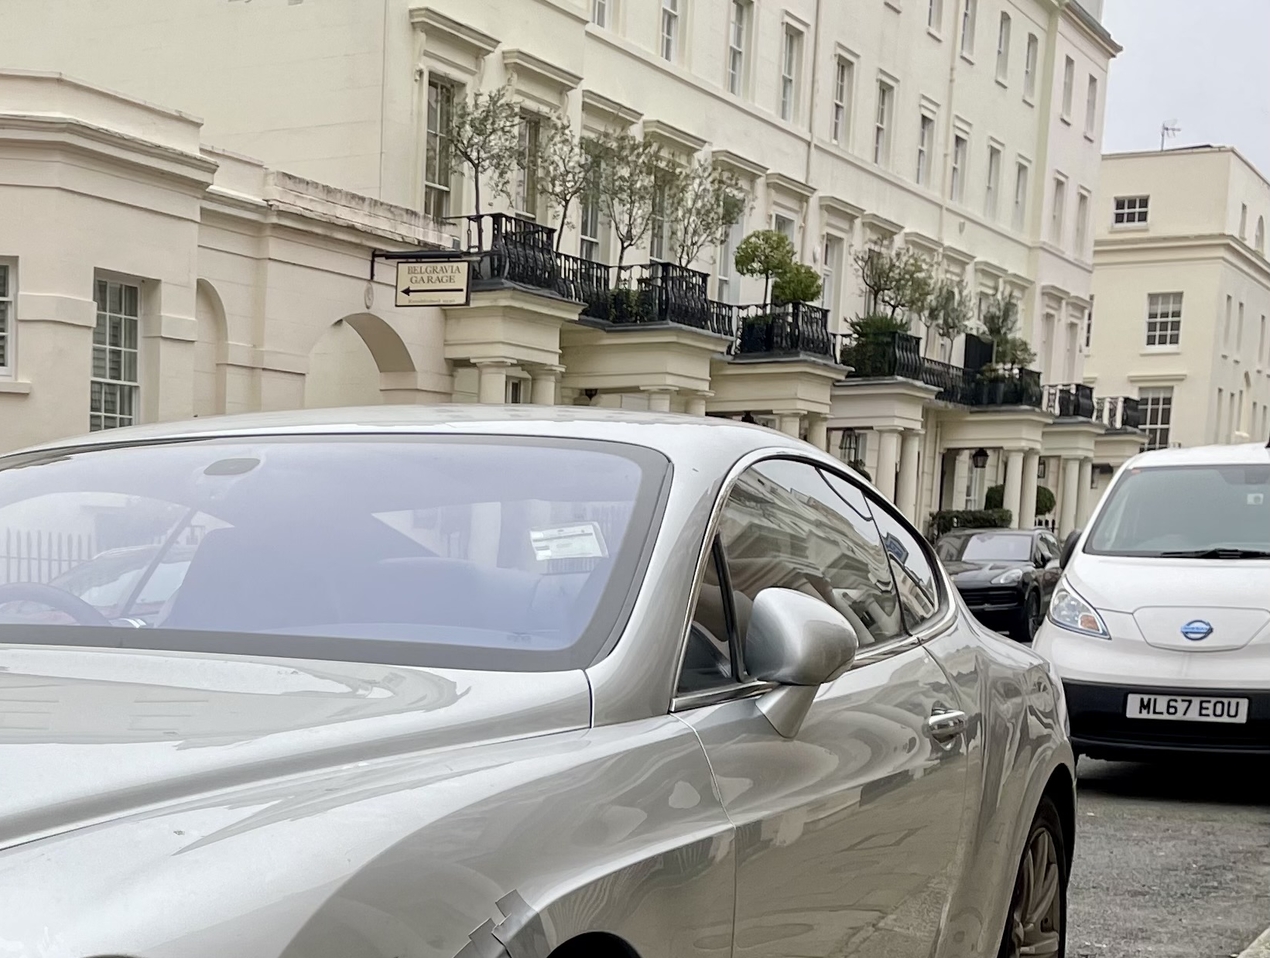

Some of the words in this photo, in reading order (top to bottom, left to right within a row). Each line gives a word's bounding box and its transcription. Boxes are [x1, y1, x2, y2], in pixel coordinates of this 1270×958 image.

[407, 265, 461, 275] BELGRAVIA
[410, 275, 456, 284] GARAGE
[1138, 697, 1193, 716] ML67
[1198, 700, 1240, 718] EOU
